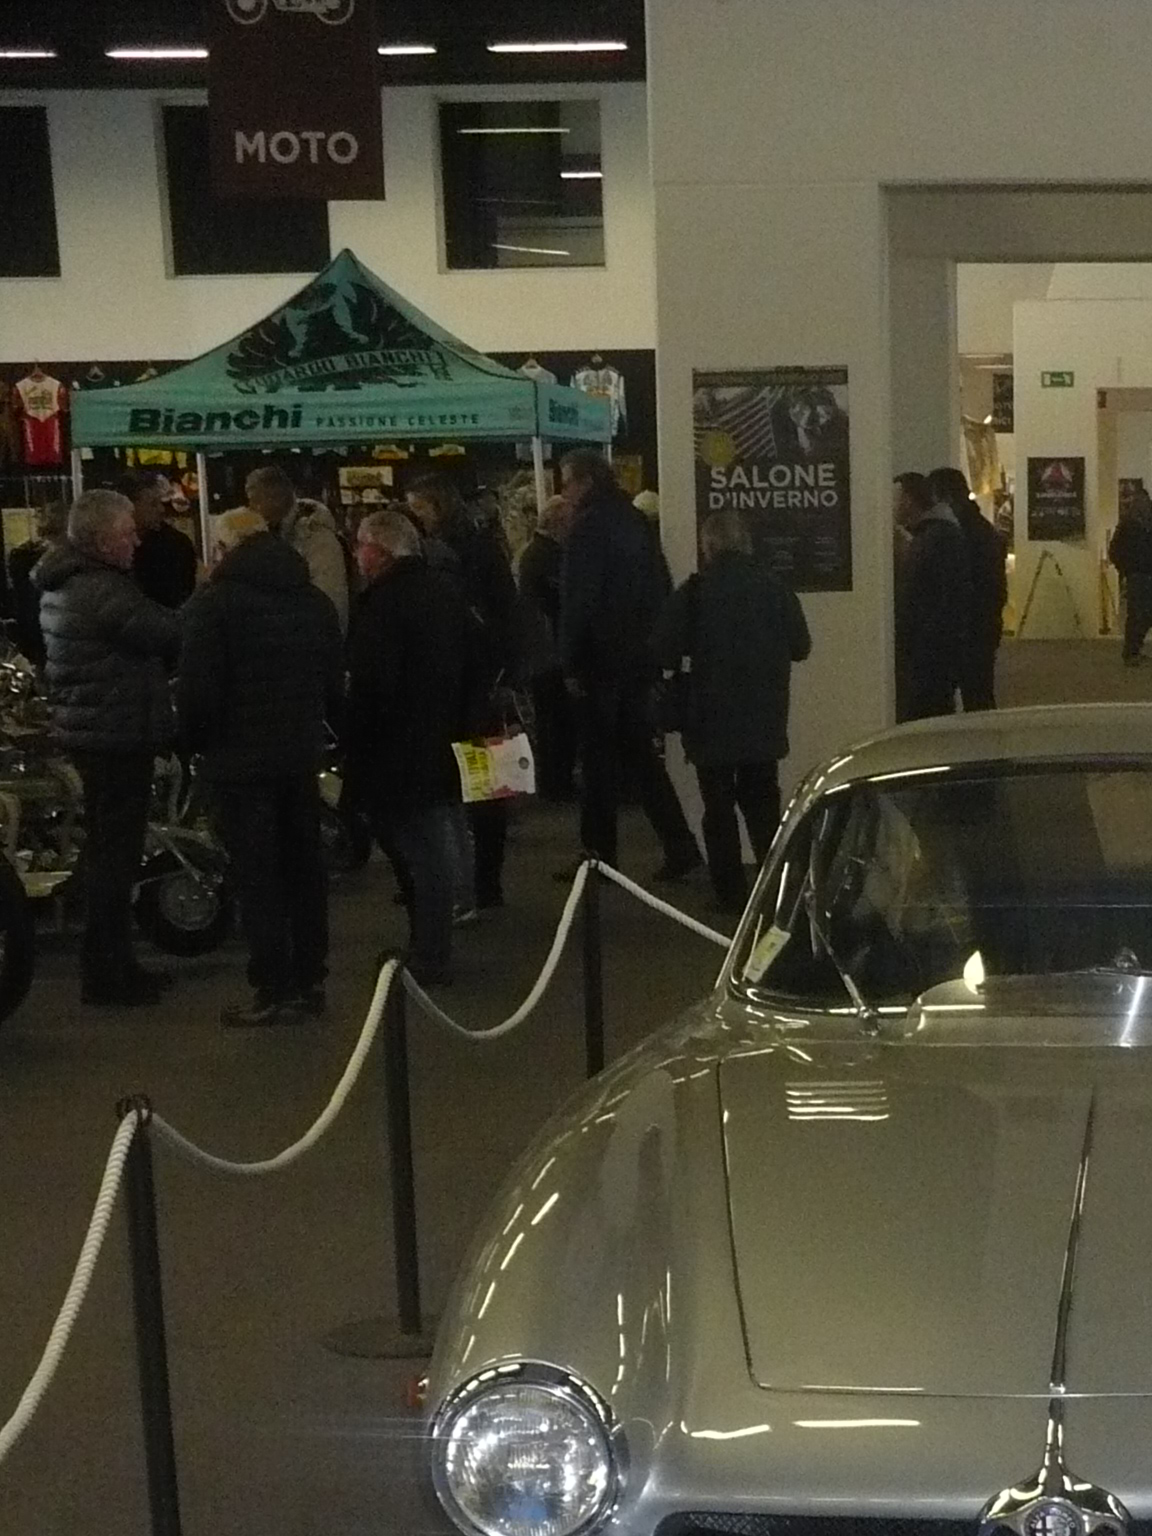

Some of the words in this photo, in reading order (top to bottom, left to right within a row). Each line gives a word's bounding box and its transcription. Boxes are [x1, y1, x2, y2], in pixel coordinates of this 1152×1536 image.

[235, 130, 359, 164] MOTO
[129, 403, 303, 433] Bianchi
[316, 415, 398, 428] PASSIONE
[408, 413, 480, 426] CELESTE
[710, 463, 838, 489] SALONE
[708, 490, 839, 509] D'INVERNO
